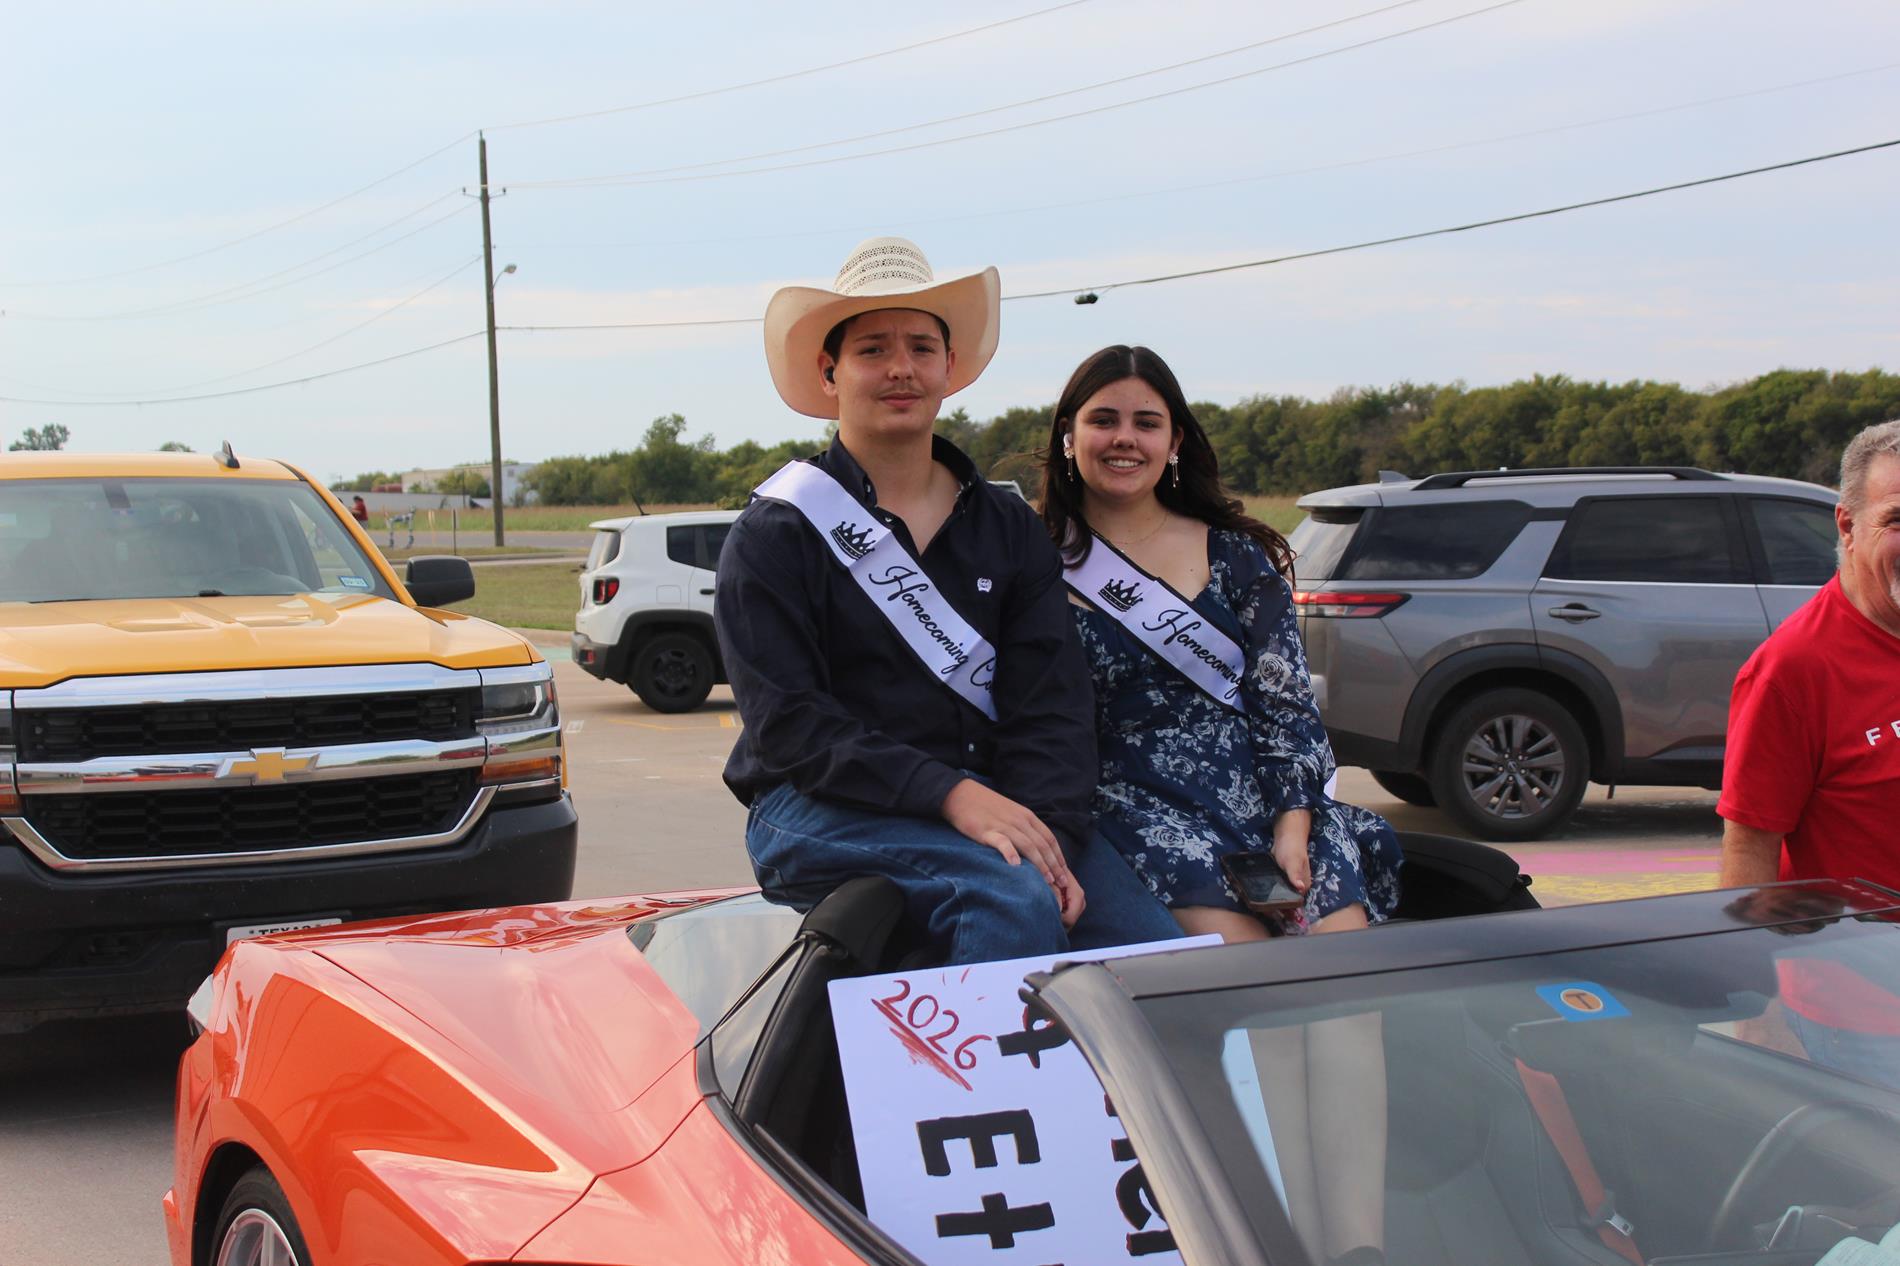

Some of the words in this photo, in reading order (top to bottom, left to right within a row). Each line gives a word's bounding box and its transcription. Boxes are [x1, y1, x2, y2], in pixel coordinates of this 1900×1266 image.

[868, 565, 970, 675] Homecoming
[1142, 609, 1242, 700] Homecoming
[880, 979, 993, 1071] 2026
[916, 1109, 1064, 1266] Et
